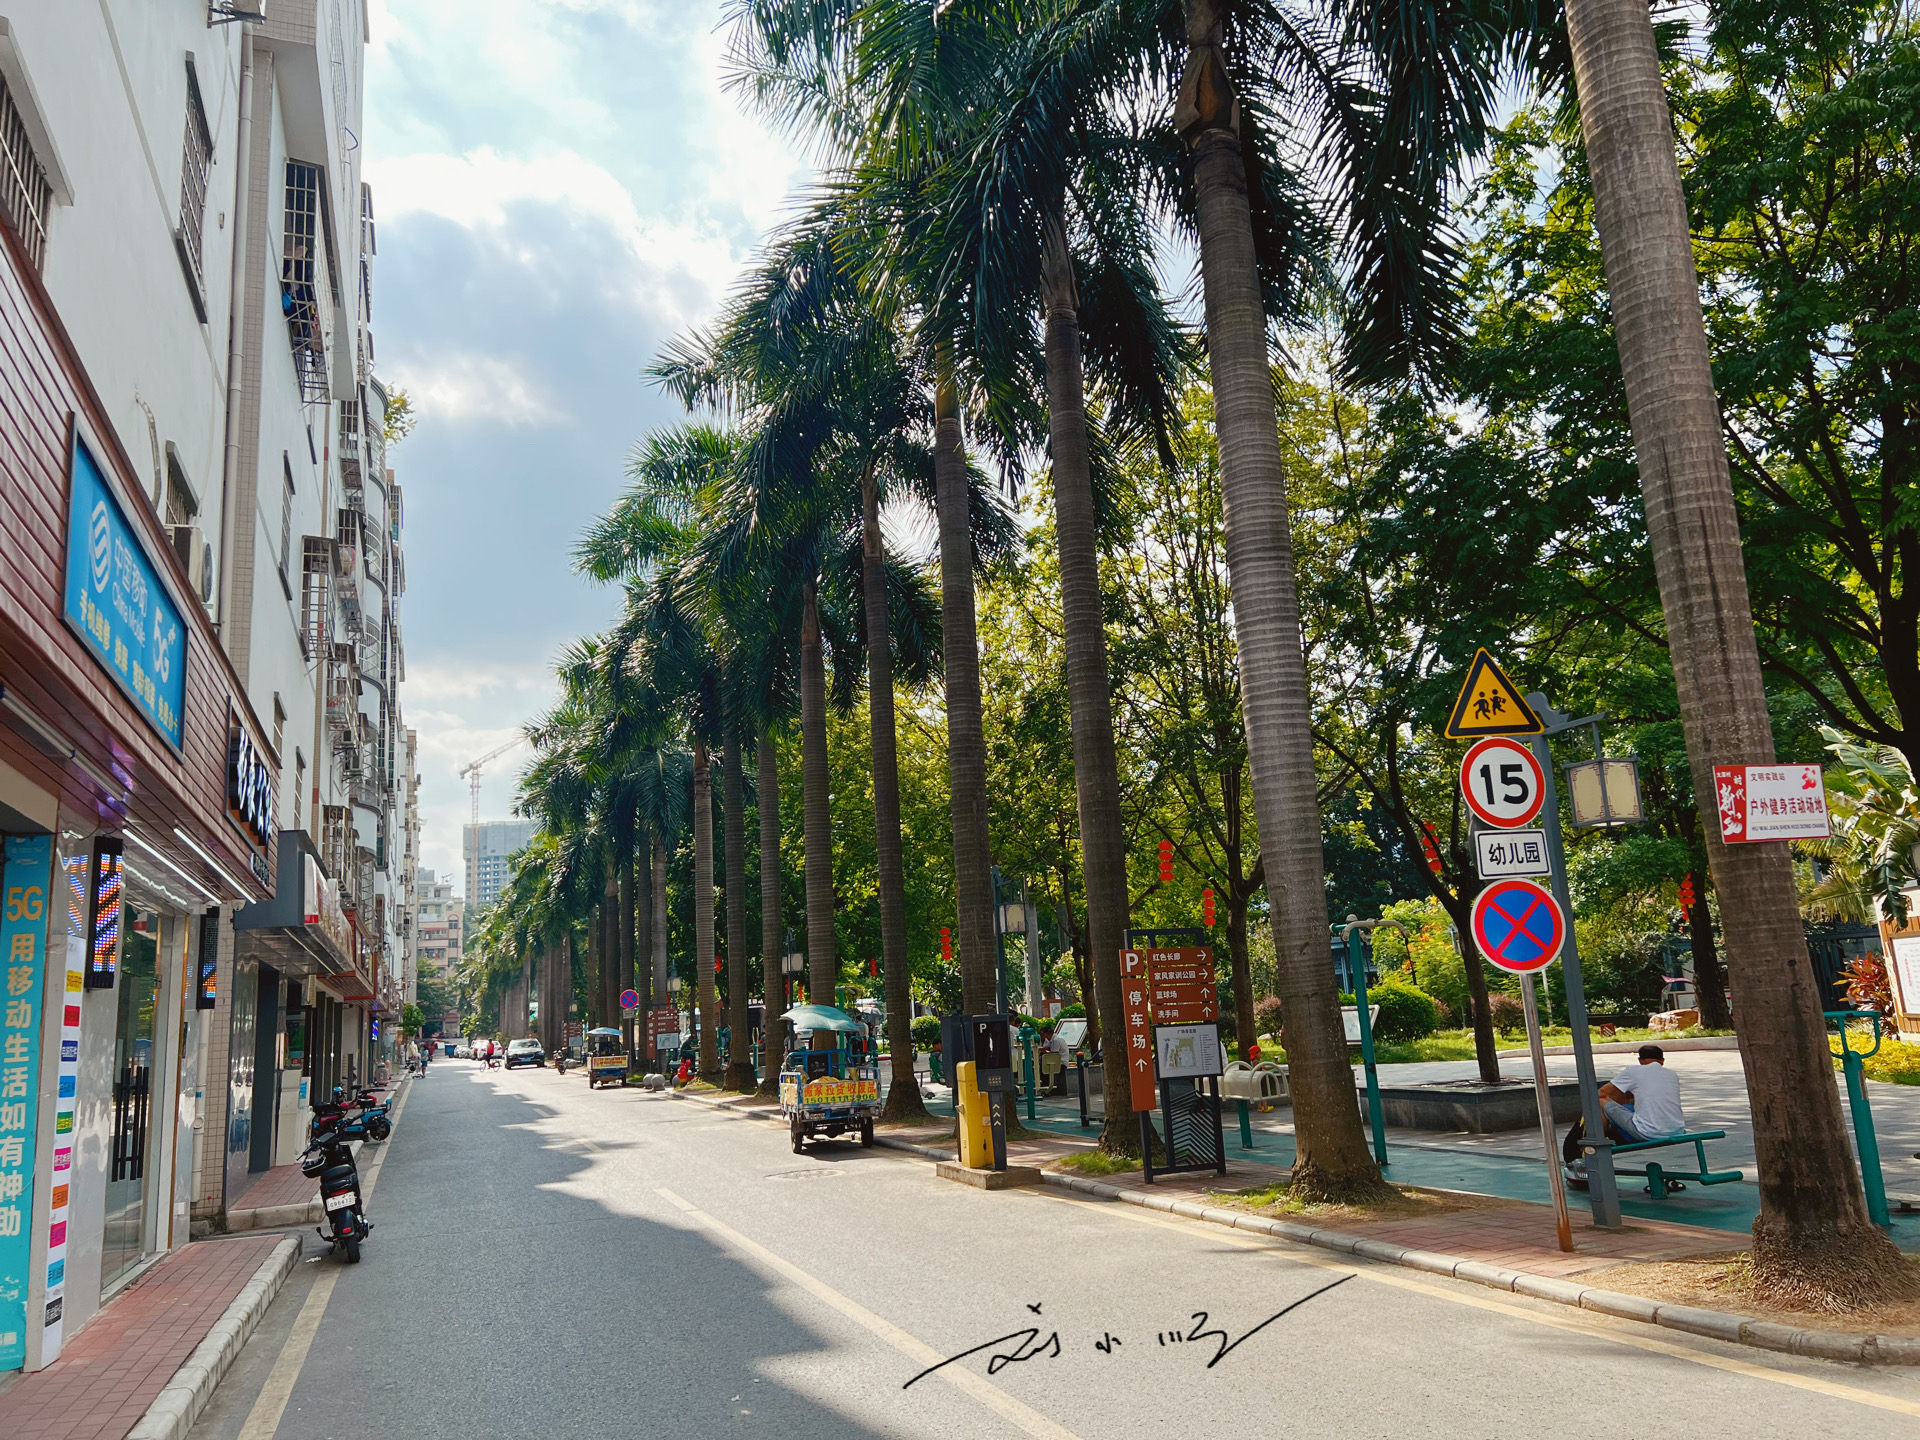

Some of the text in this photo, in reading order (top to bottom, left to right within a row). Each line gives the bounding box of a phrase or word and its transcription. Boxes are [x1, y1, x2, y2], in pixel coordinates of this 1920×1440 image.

[114, 536, 148, 618] 中国移动
[112, 581, 146, 648] China Mobile
[153, 606, 170, 683] 5G
[1480, 764, 1529, 805] 15
[1733, 774, 1746, 801] 时代
[1750, 772, 1786, 782] 文明实践站
[1750, 796, 1824, 816] 户外健身活动场地
[1489, 841, 1541, 866] 幼儿园
[6, 886, 43, 921] 5G
[1125, 952, 1139, 972] P
[1152, 952, 1181, 962] 红色长廊
[1154, 971, 1196, 981] 家风家训公园
[1156, 990, 1178, 999] 篮球场
[648, 1010, 654, 1018] P
[1128, 990, 1147, 1050] 停车场
[1157, 1009, 1179, 1019] 洗手间
[979, 1023, 987, 1034] P
[0, 933, 35, 1237] 用移动生活如有神助
